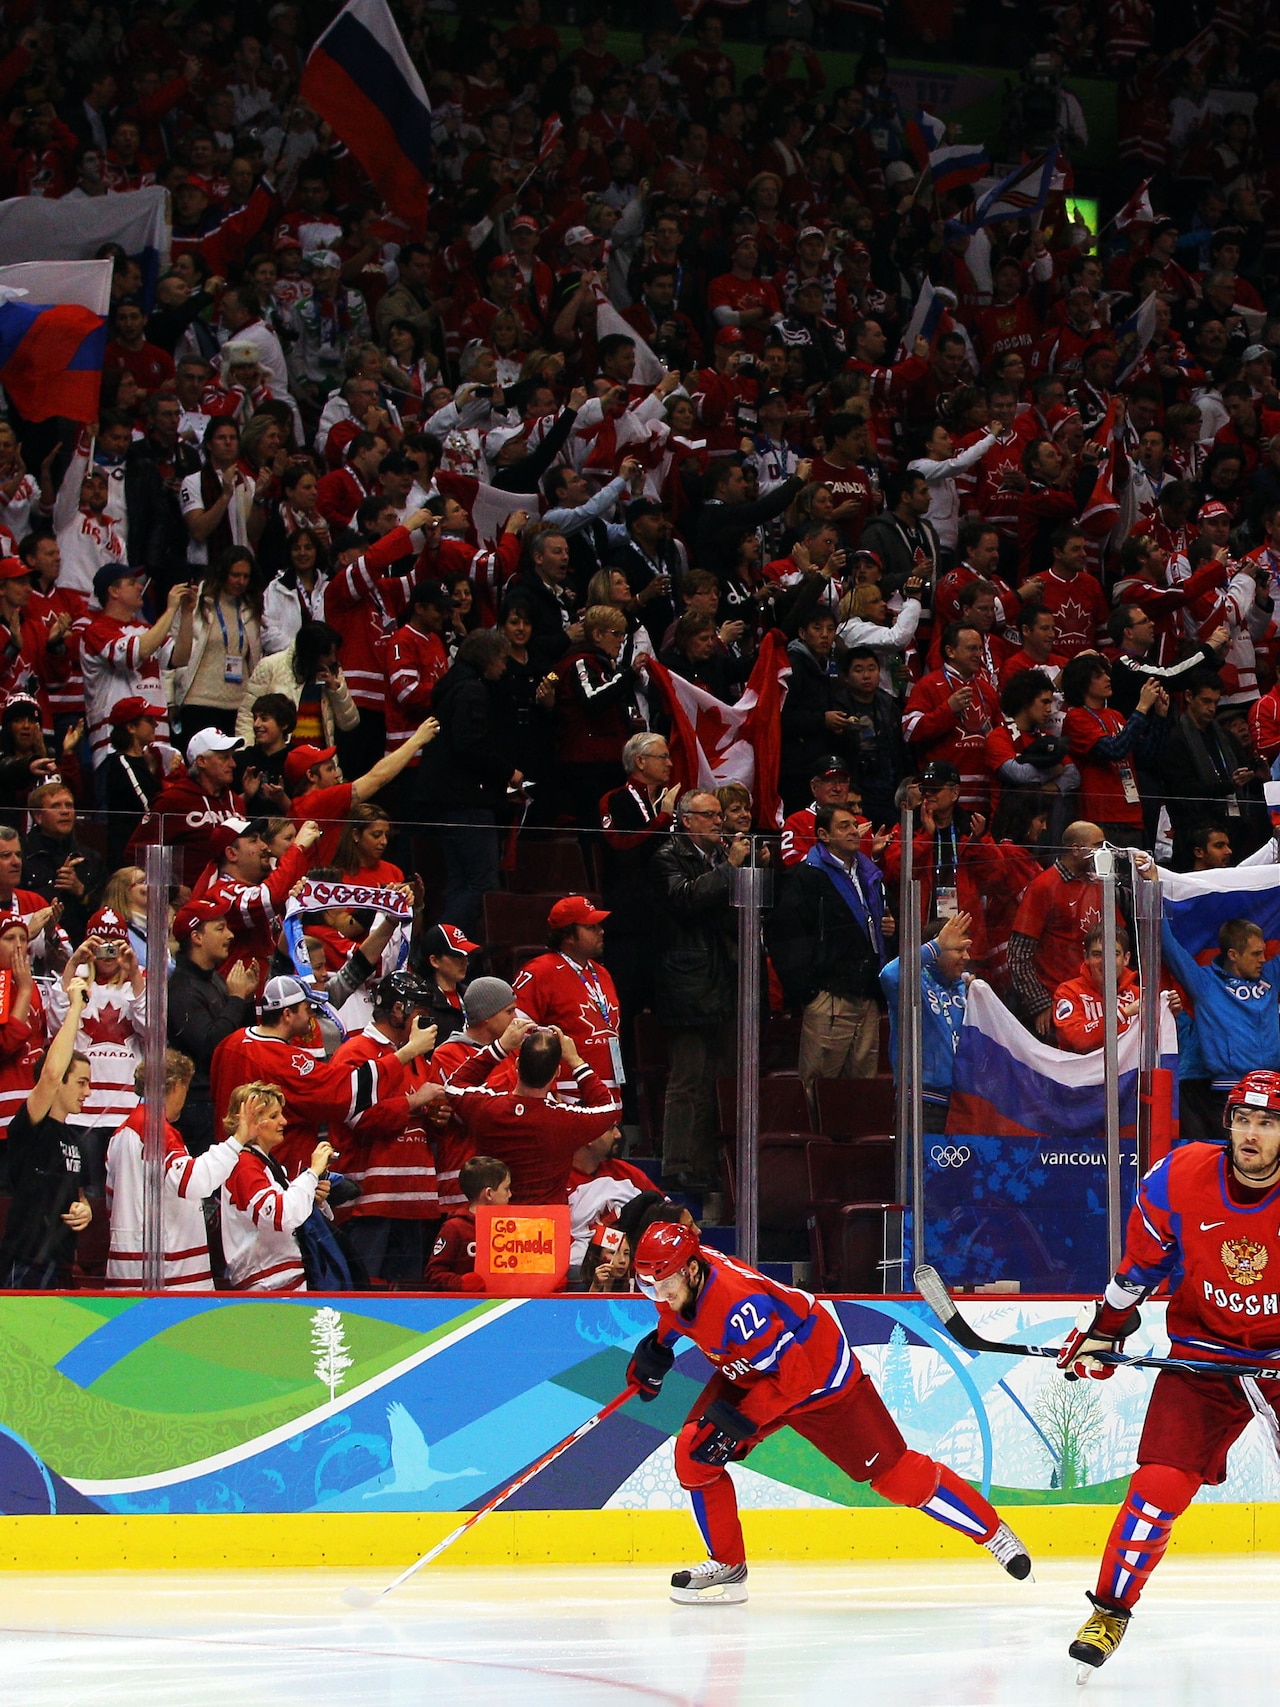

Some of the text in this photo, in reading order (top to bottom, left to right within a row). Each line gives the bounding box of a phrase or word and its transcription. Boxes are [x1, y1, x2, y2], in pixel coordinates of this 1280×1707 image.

[394, 643, 401, 660] 1
[781, 831, 793, 850] 2
[512, 969, 532, 989] 17
[492, 1231, 553, 1255] Canada
[730, 1301, 767, 1341] 22
